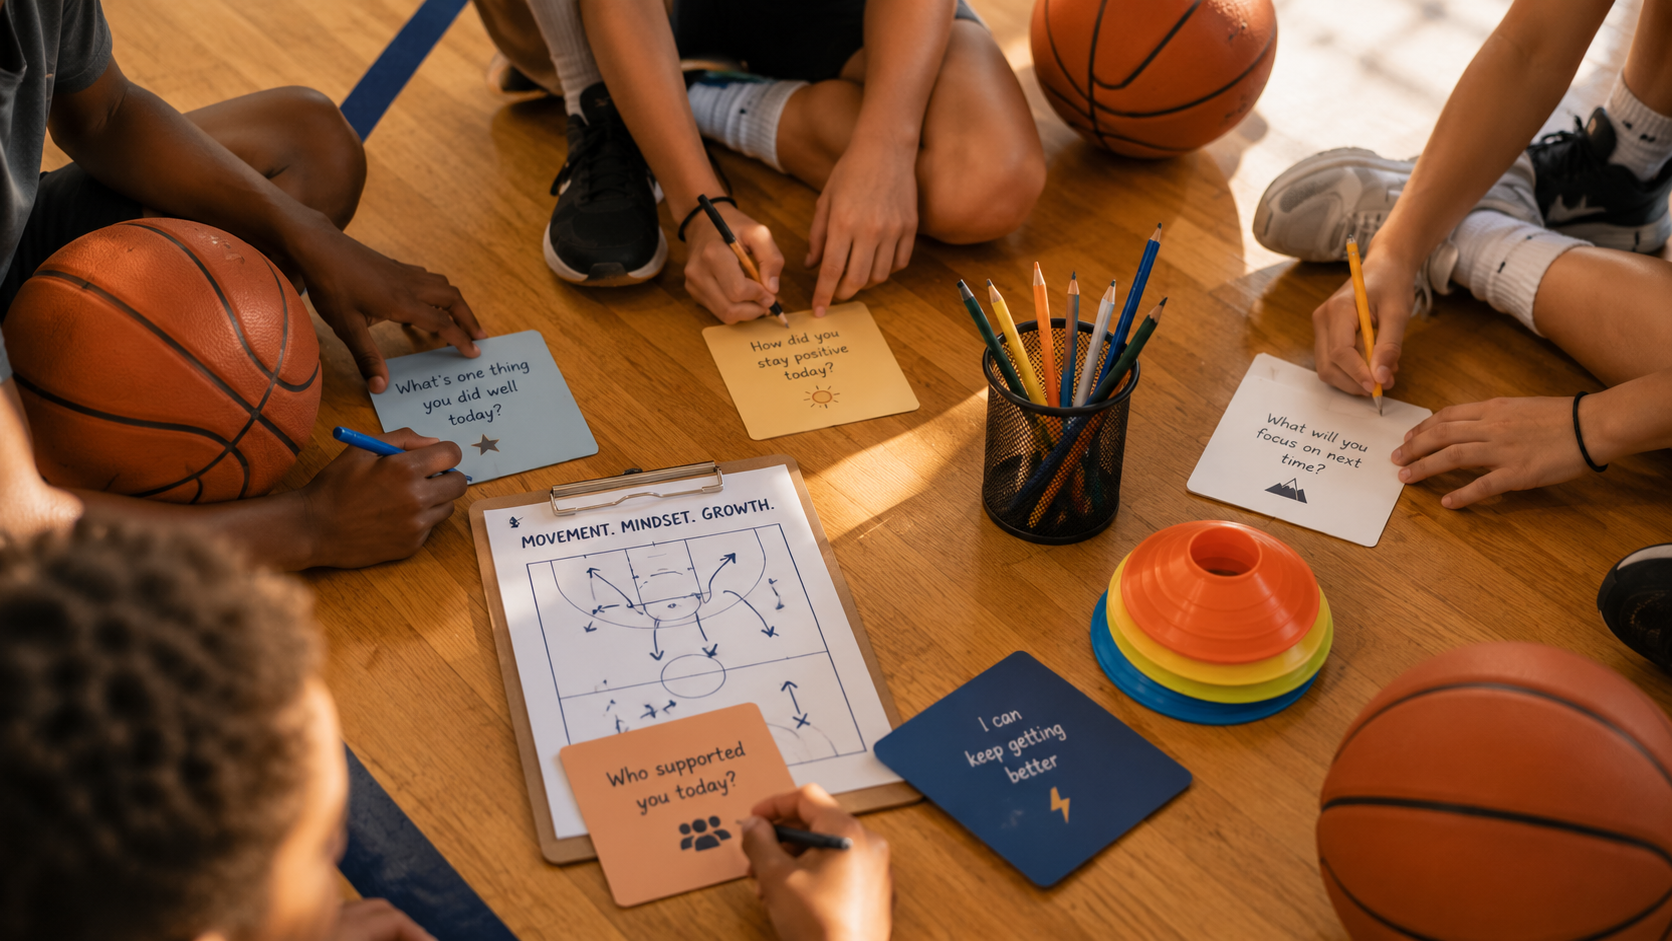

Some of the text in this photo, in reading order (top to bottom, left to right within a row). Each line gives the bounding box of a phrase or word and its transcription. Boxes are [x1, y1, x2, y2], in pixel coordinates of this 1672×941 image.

[749, 329, 840, 353] How did you
[757, 344, 850, 370] stay positive
[395, 361, 530, 395] What's one thing
[783, 361, 835, 382] today?
[422, 379, 519, 415] you did well
[447, 403, 503, 426] today?
[1256, 427, 1363, 470] focus on next
[1267, 412, 1369, 454] What will you
[1280, 453, 1327, 476] time?
[521, 498, 776, 550] MOVEMENT. MINDSET. GROWTH.
[977, 709, 1023, 733] I can
[964, 723, 1068, 768] keep getting
[605, 740, 747, 788] Who supported
[1004, 754, 1059, 784] better
[635, 770, 737, 816] you today?
